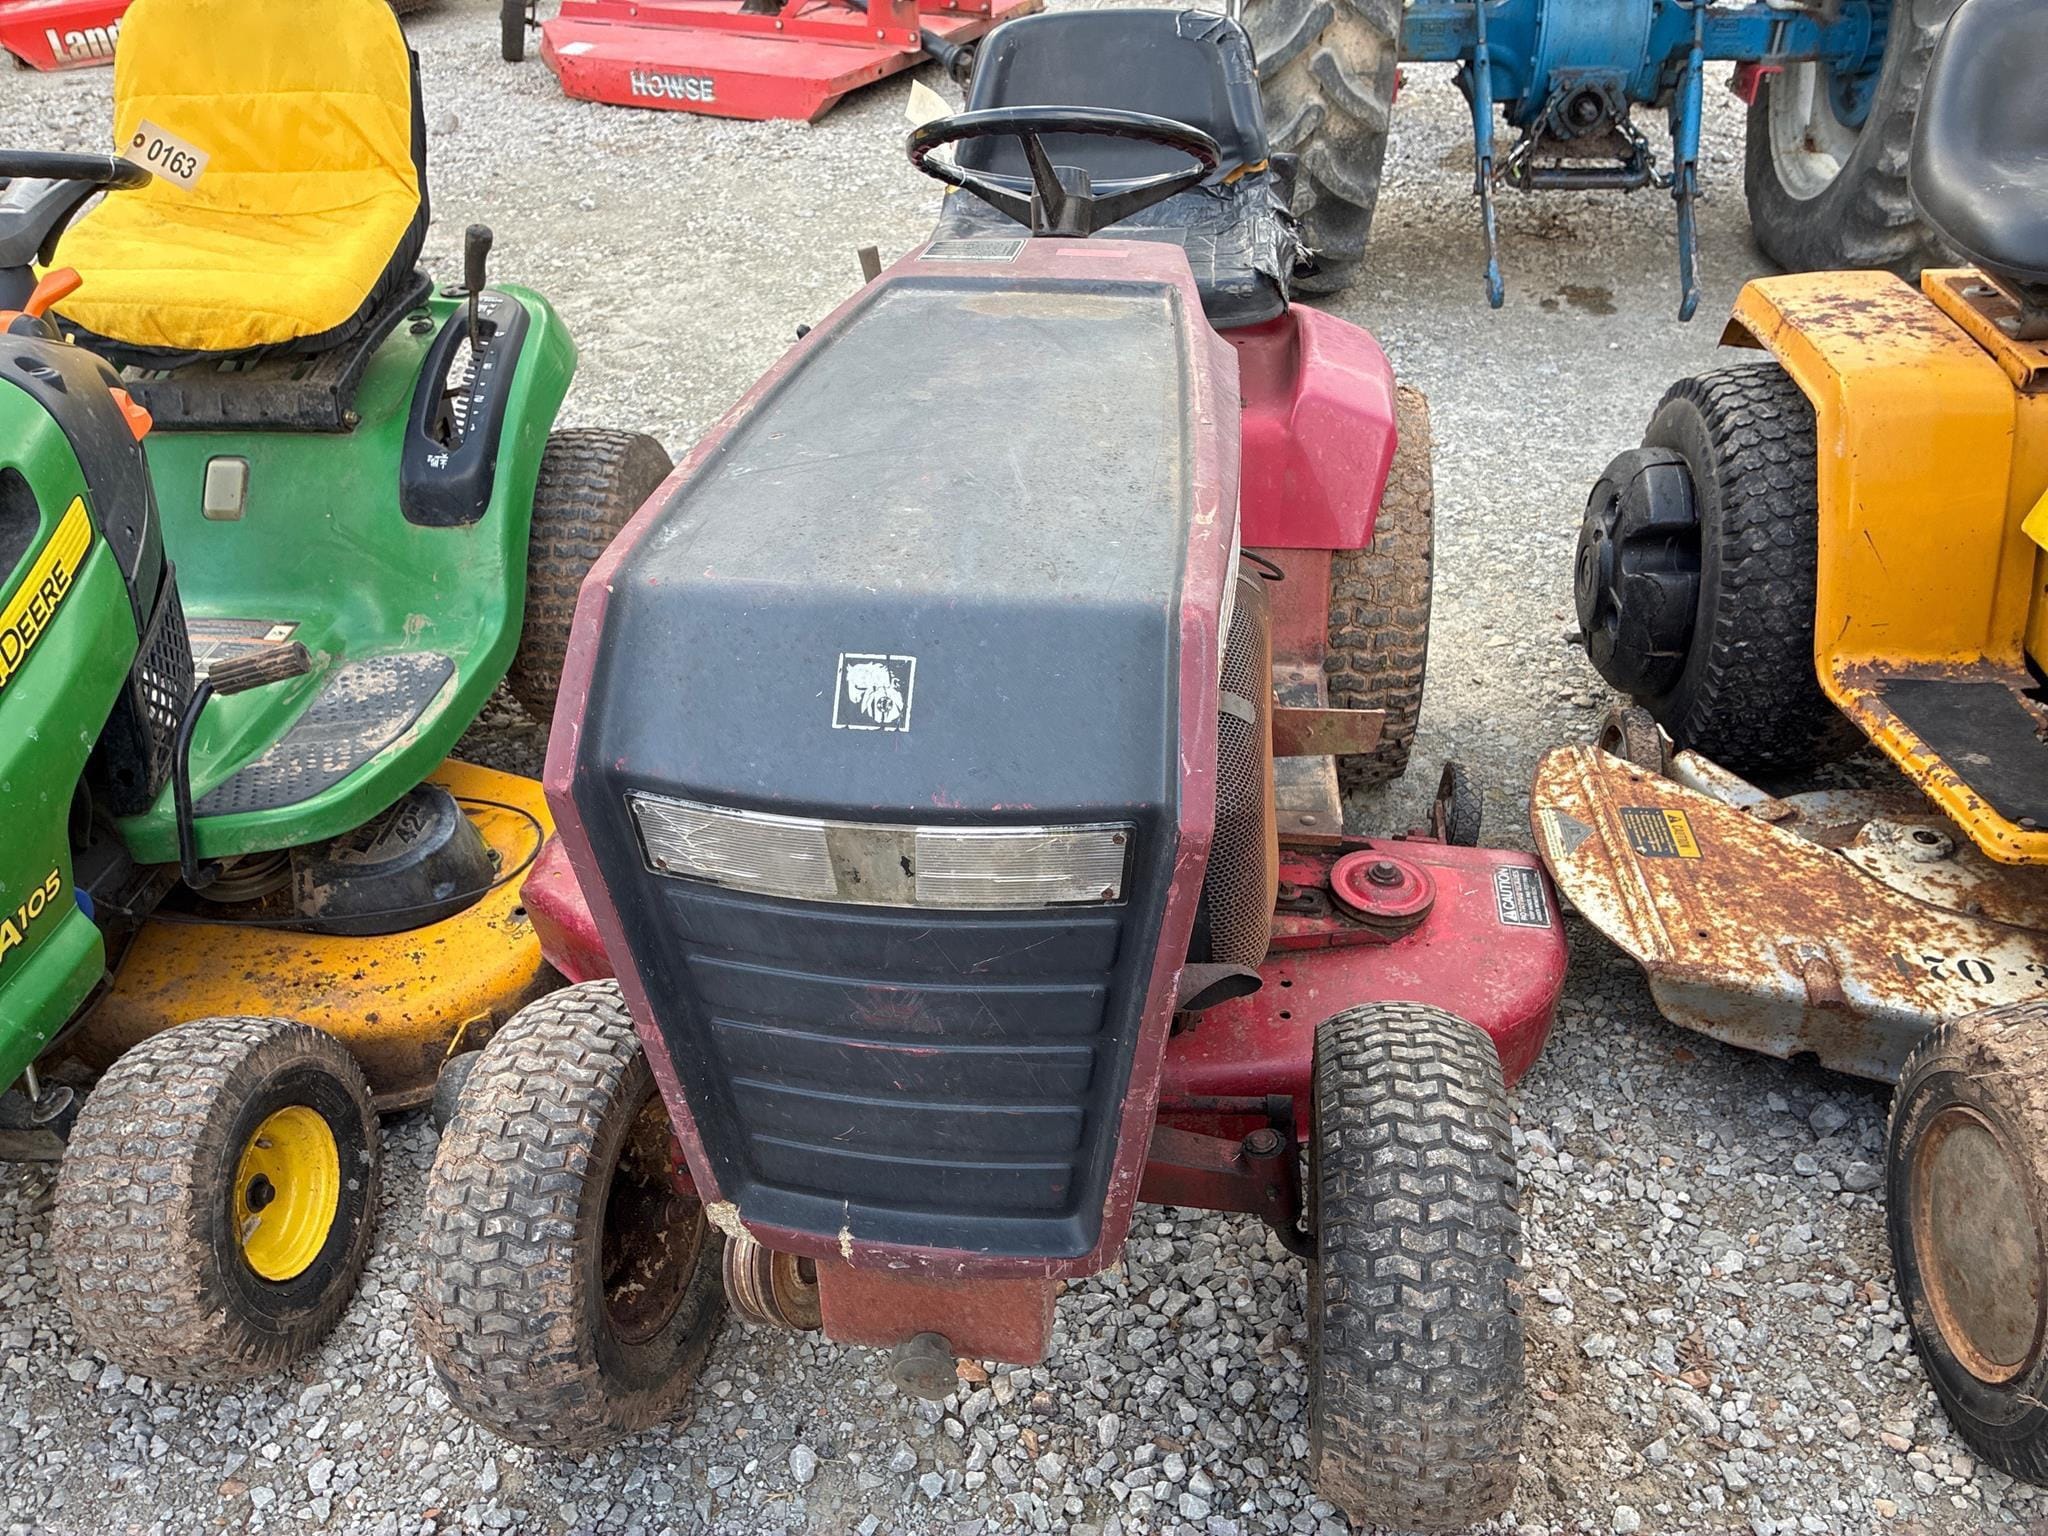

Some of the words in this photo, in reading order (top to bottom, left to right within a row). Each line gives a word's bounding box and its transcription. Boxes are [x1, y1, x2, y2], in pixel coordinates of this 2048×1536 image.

[630, 69, 716, 102] HOWSE
[147, 138, 197, 179] 0163
[0, 557, 72, 672] DEERE
[1498, 868, 1516, 910] CAUTION
